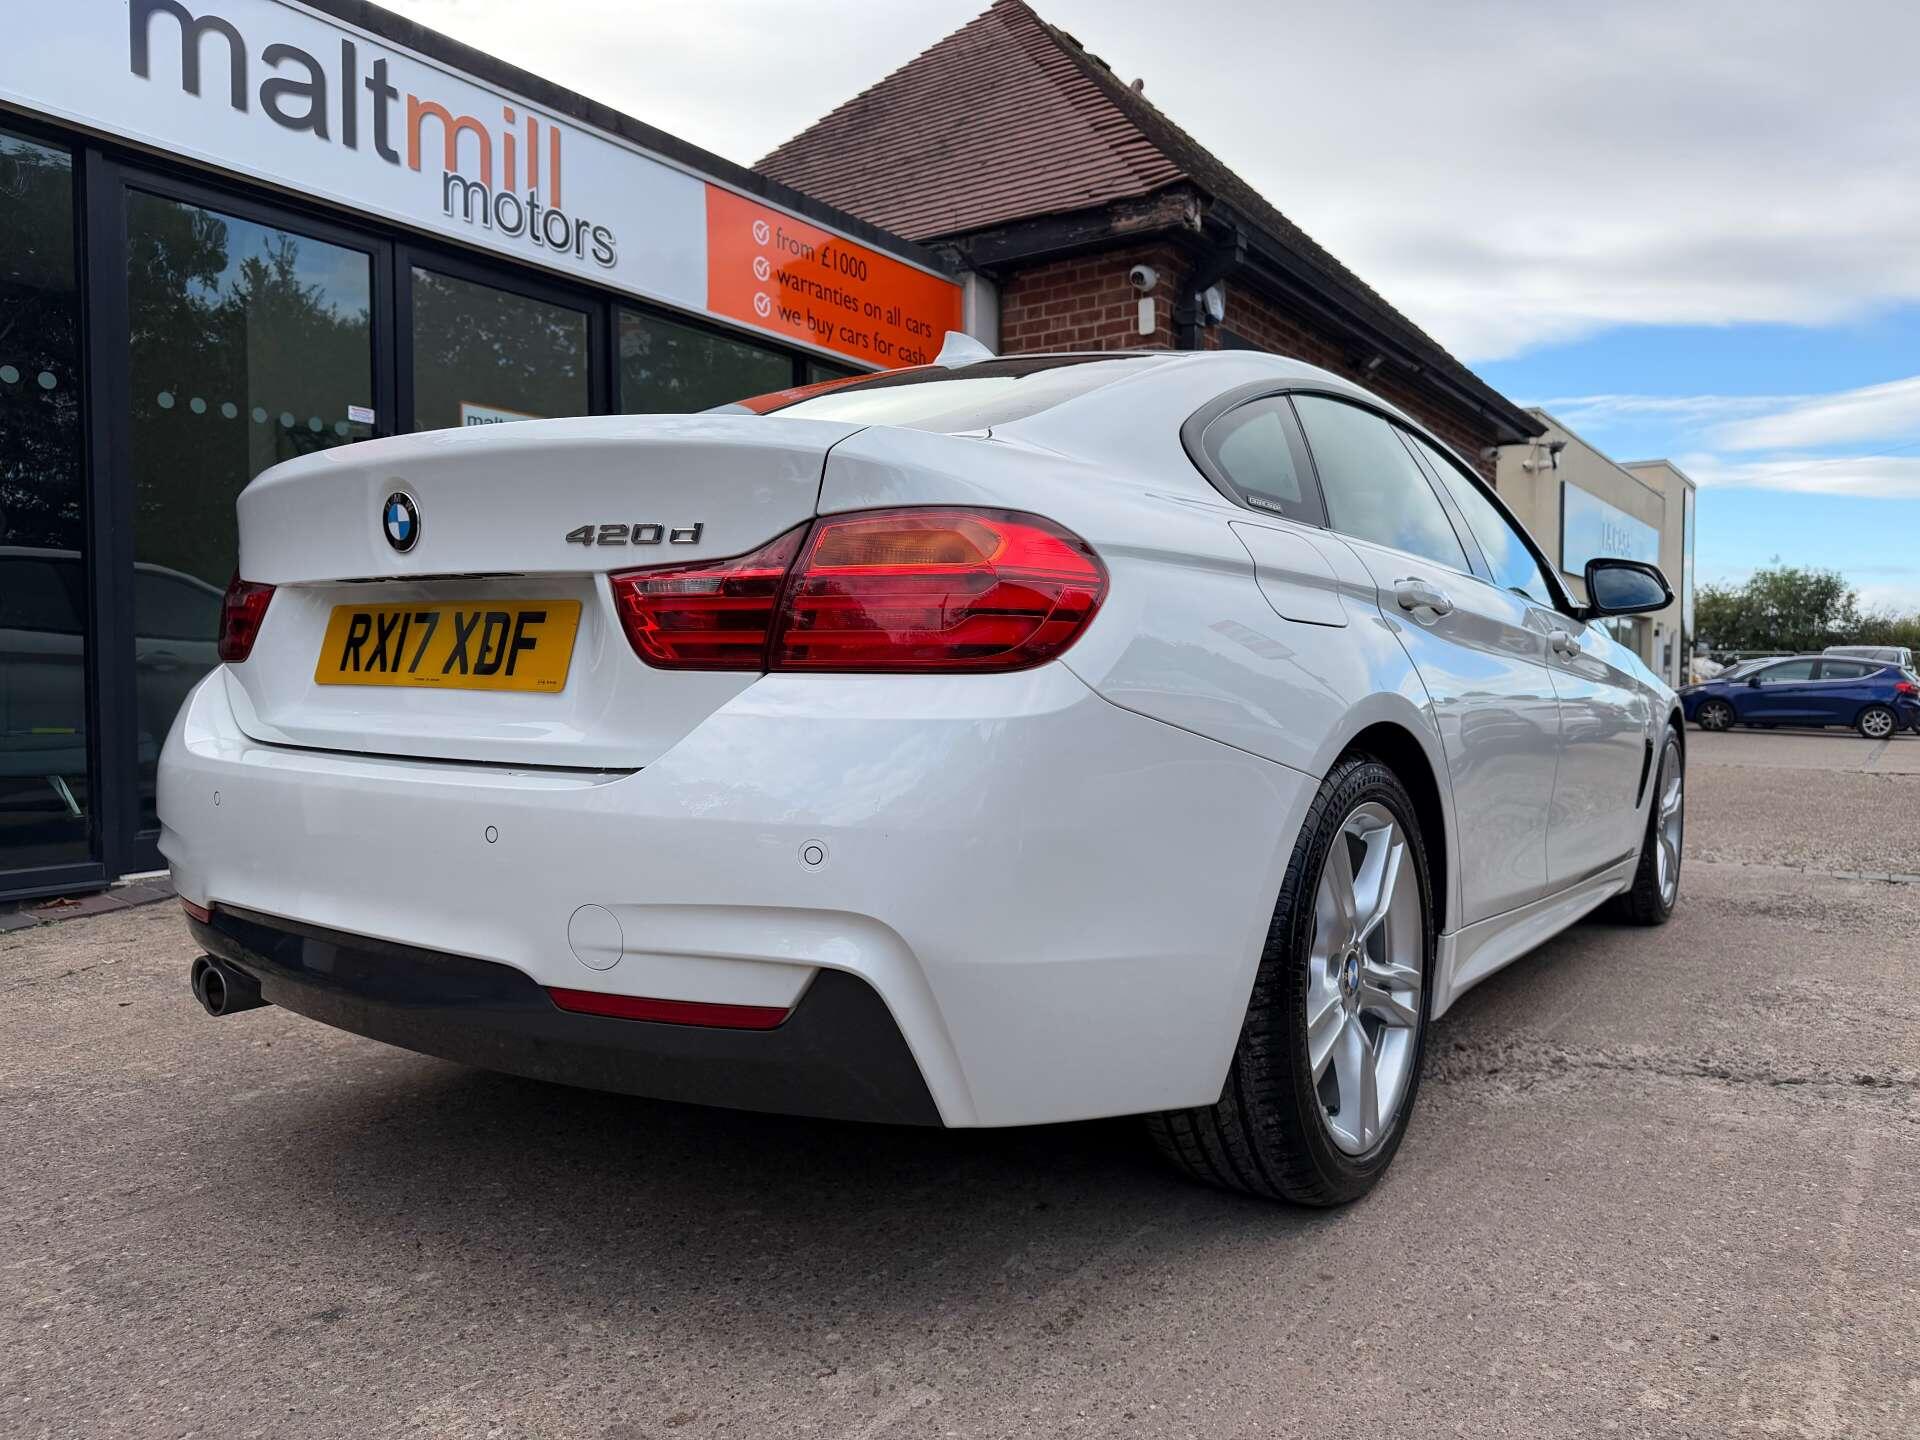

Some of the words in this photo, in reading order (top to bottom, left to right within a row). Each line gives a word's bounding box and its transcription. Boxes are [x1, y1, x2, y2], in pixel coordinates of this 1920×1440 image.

[443, 170, 615, 265] motors
[776, 227, 815, 262] from
[821, 246, 868, 282] £1000
[776, 269, 859, 313] warranties
[864, 301, 882, 320] on
[886, 305, 901, 328] all
[905, 317, 932, 338] cars
[777, 304, 801, 326] we
[807, 308, 834, 342] buy
[839, 326, 869, 348] cars
[873, 332, 894, 355] for
[898, 345, 927, 364] cash
[565, 522, 704, 546] 420d
[339, 612, 450, 673] RX17
[442, 611, 547, 676] XDF
